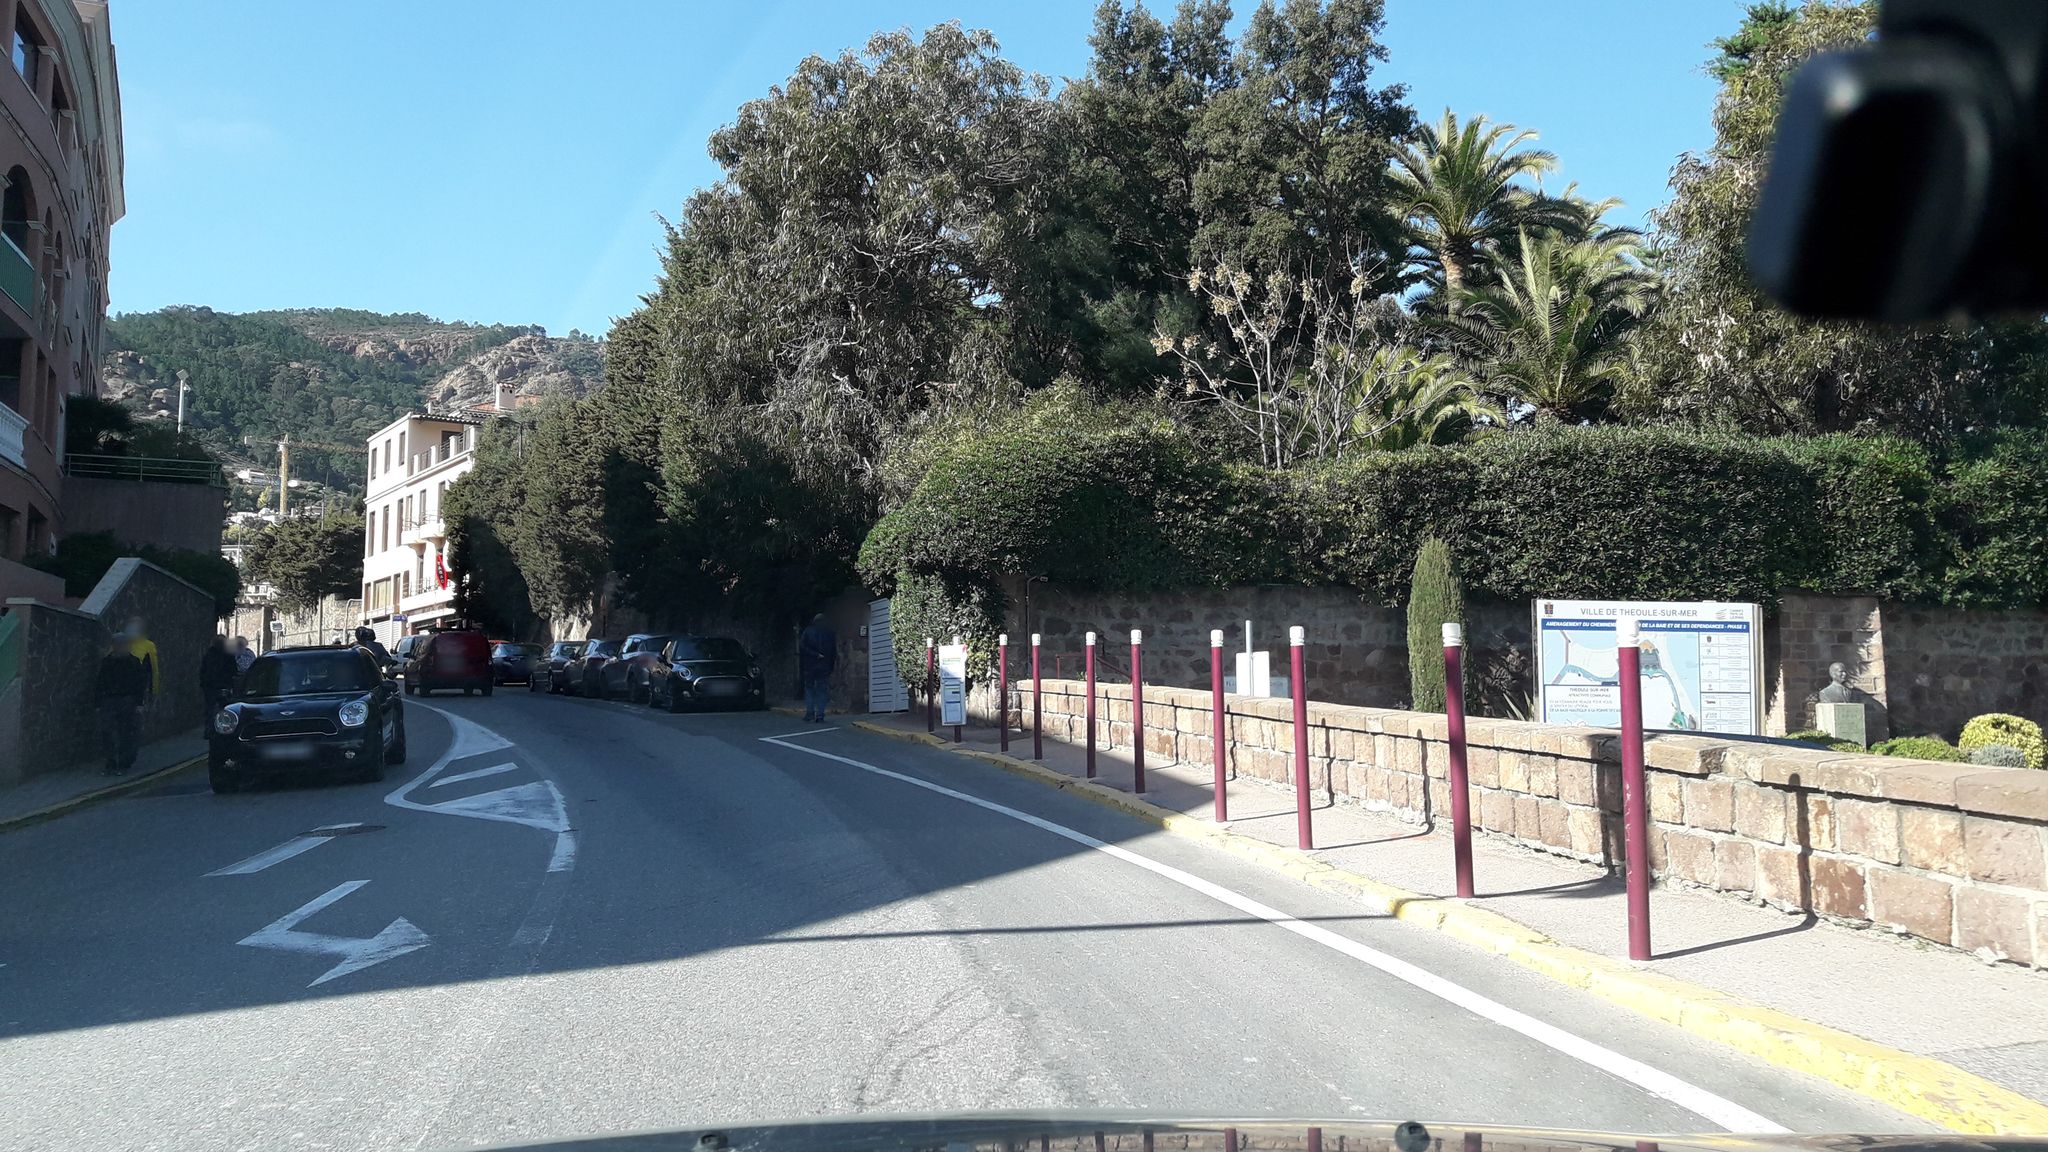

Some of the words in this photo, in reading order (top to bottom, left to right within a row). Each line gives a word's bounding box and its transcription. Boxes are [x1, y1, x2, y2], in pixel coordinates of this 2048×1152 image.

[1580, 608, 1603, 616] VILLE
[1606, 608, 1617, 616] DE
[1620, 608, 1697, 617] THEOULE-SUR-MER
